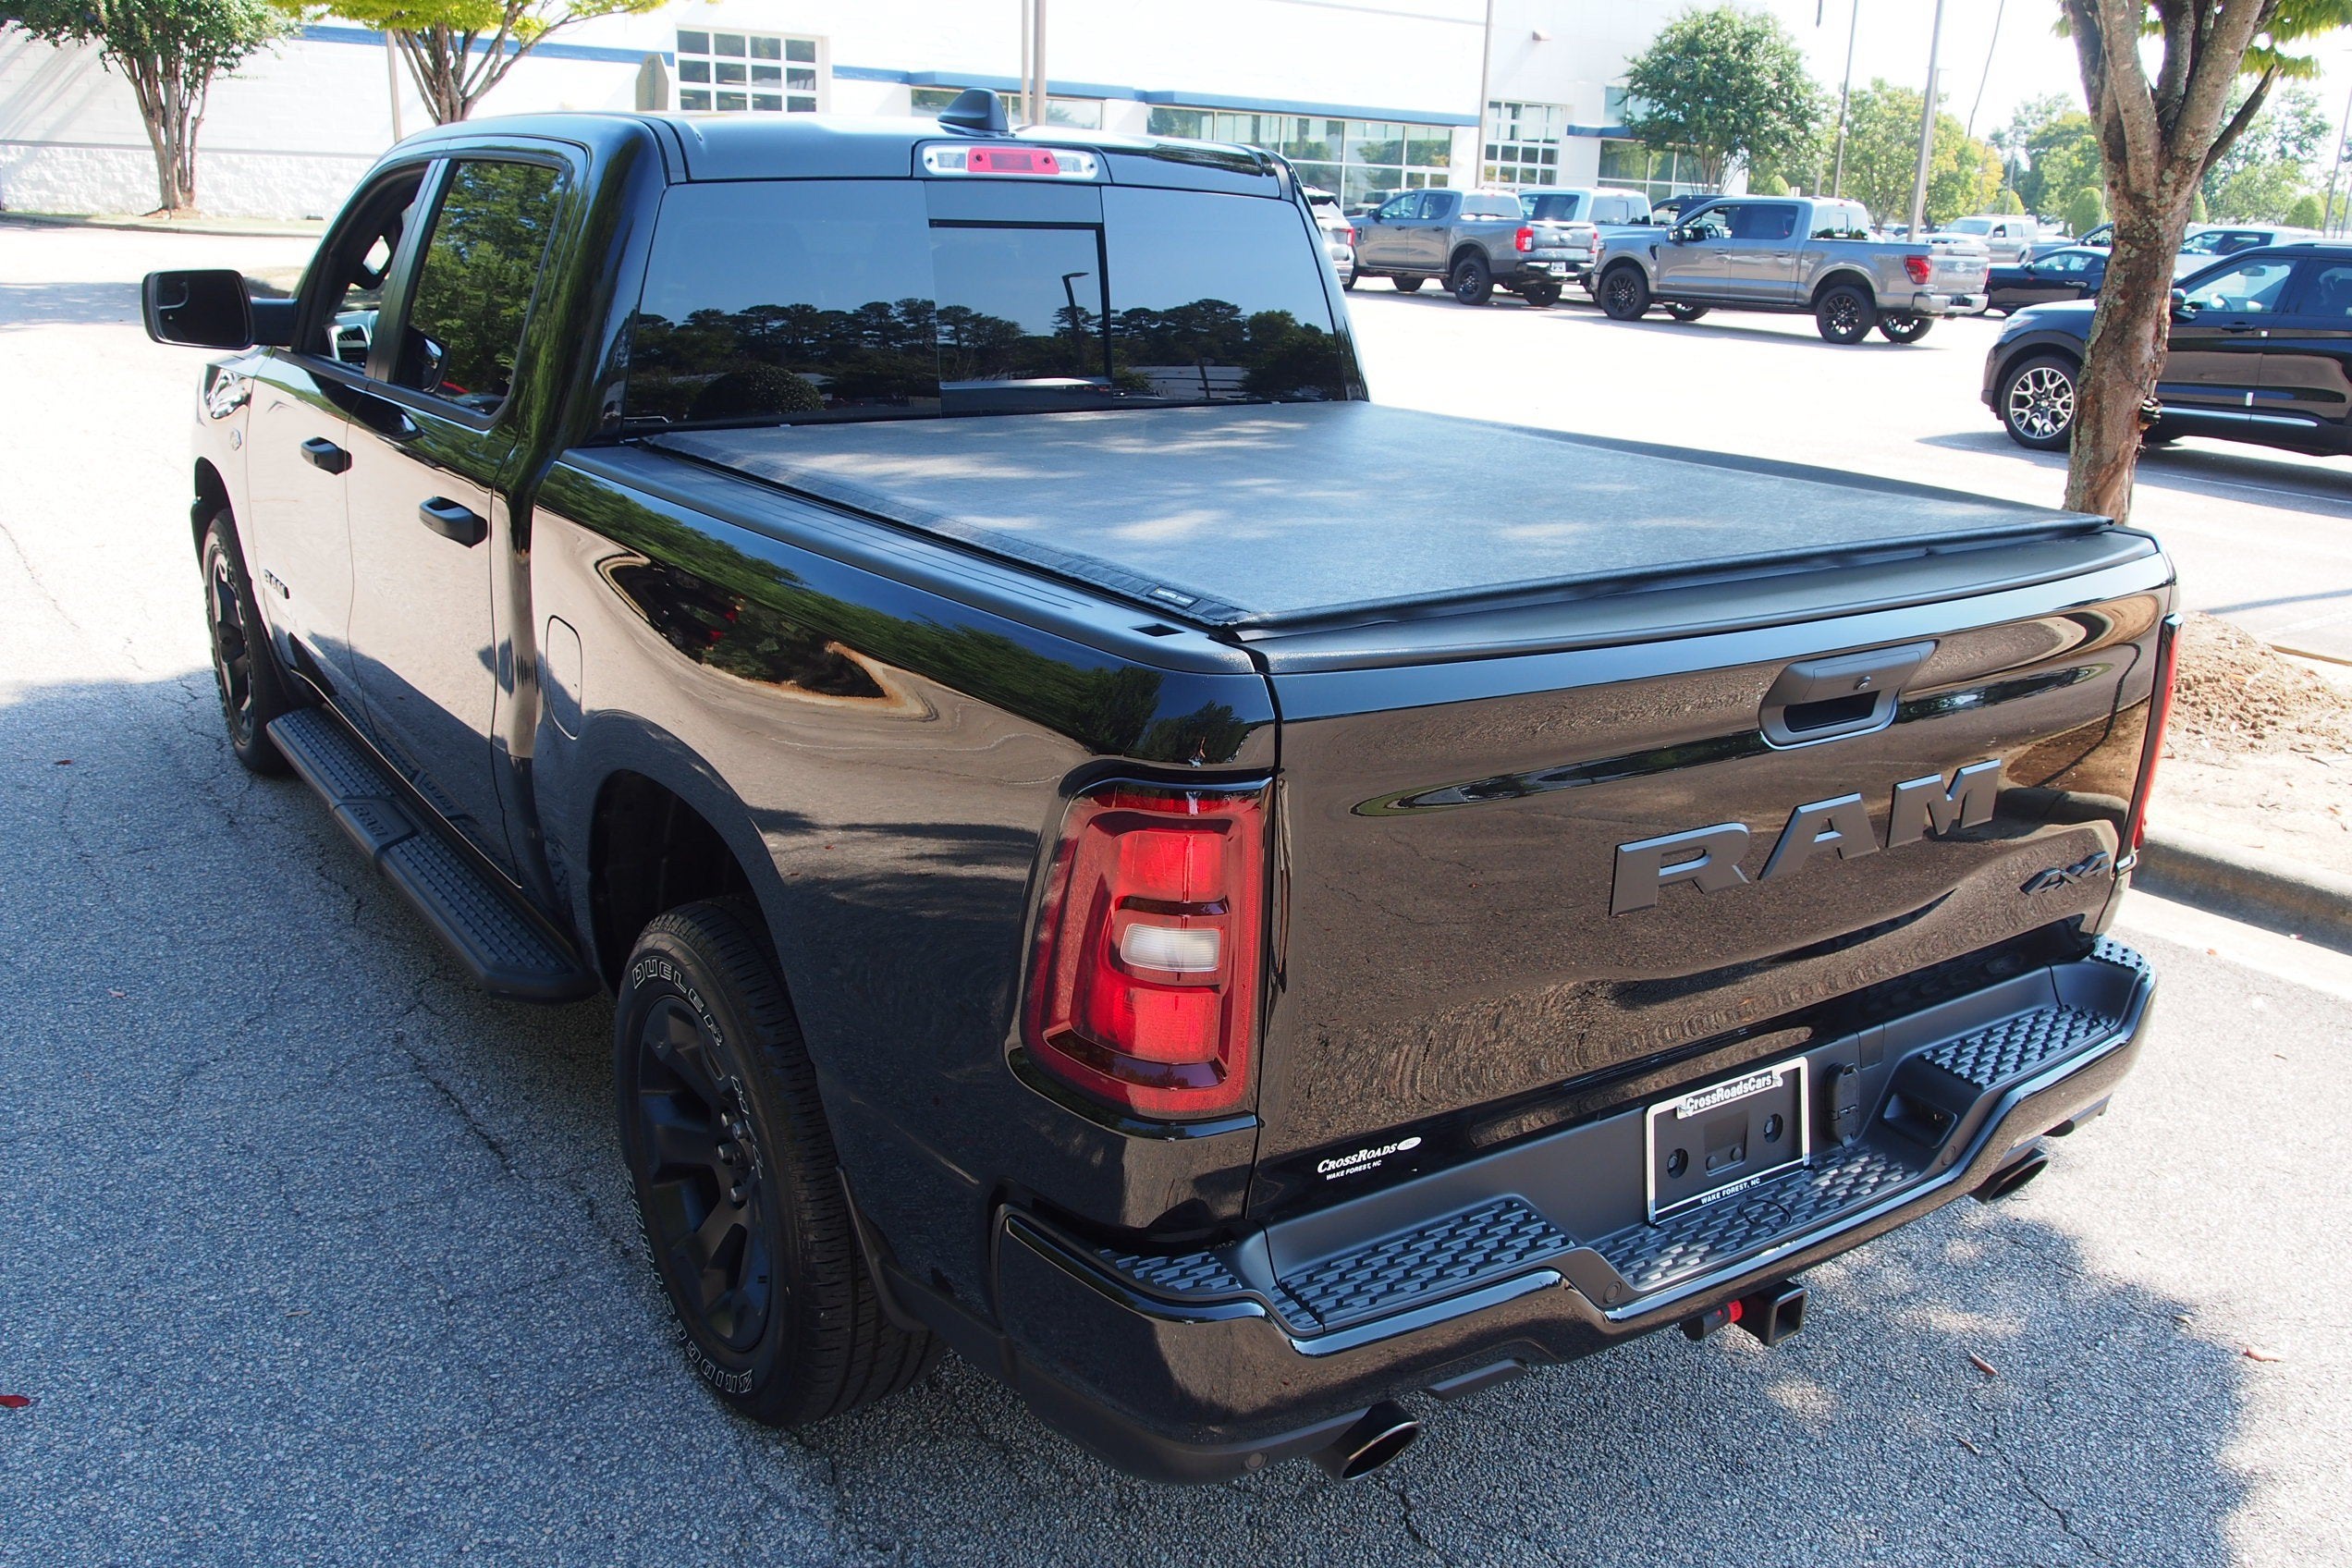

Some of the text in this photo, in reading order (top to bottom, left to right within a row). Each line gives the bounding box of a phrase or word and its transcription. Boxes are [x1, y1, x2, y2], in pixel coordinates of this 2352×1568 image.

[263, 569, 290, 600] RAM
[1609, 758, 2002, 918] RAM
[631, 959, 724, 1047] DUELER
[1686, 1074, 1772, 1111] CrossRoadsCars
[1326, 1159, 1382, 1181] WAKE FOREST, NC
[1701, 1178, 1760, 1205] WAKE FOREST, NC
[623, 1163, 753, 1394] BRIDGESTONE
